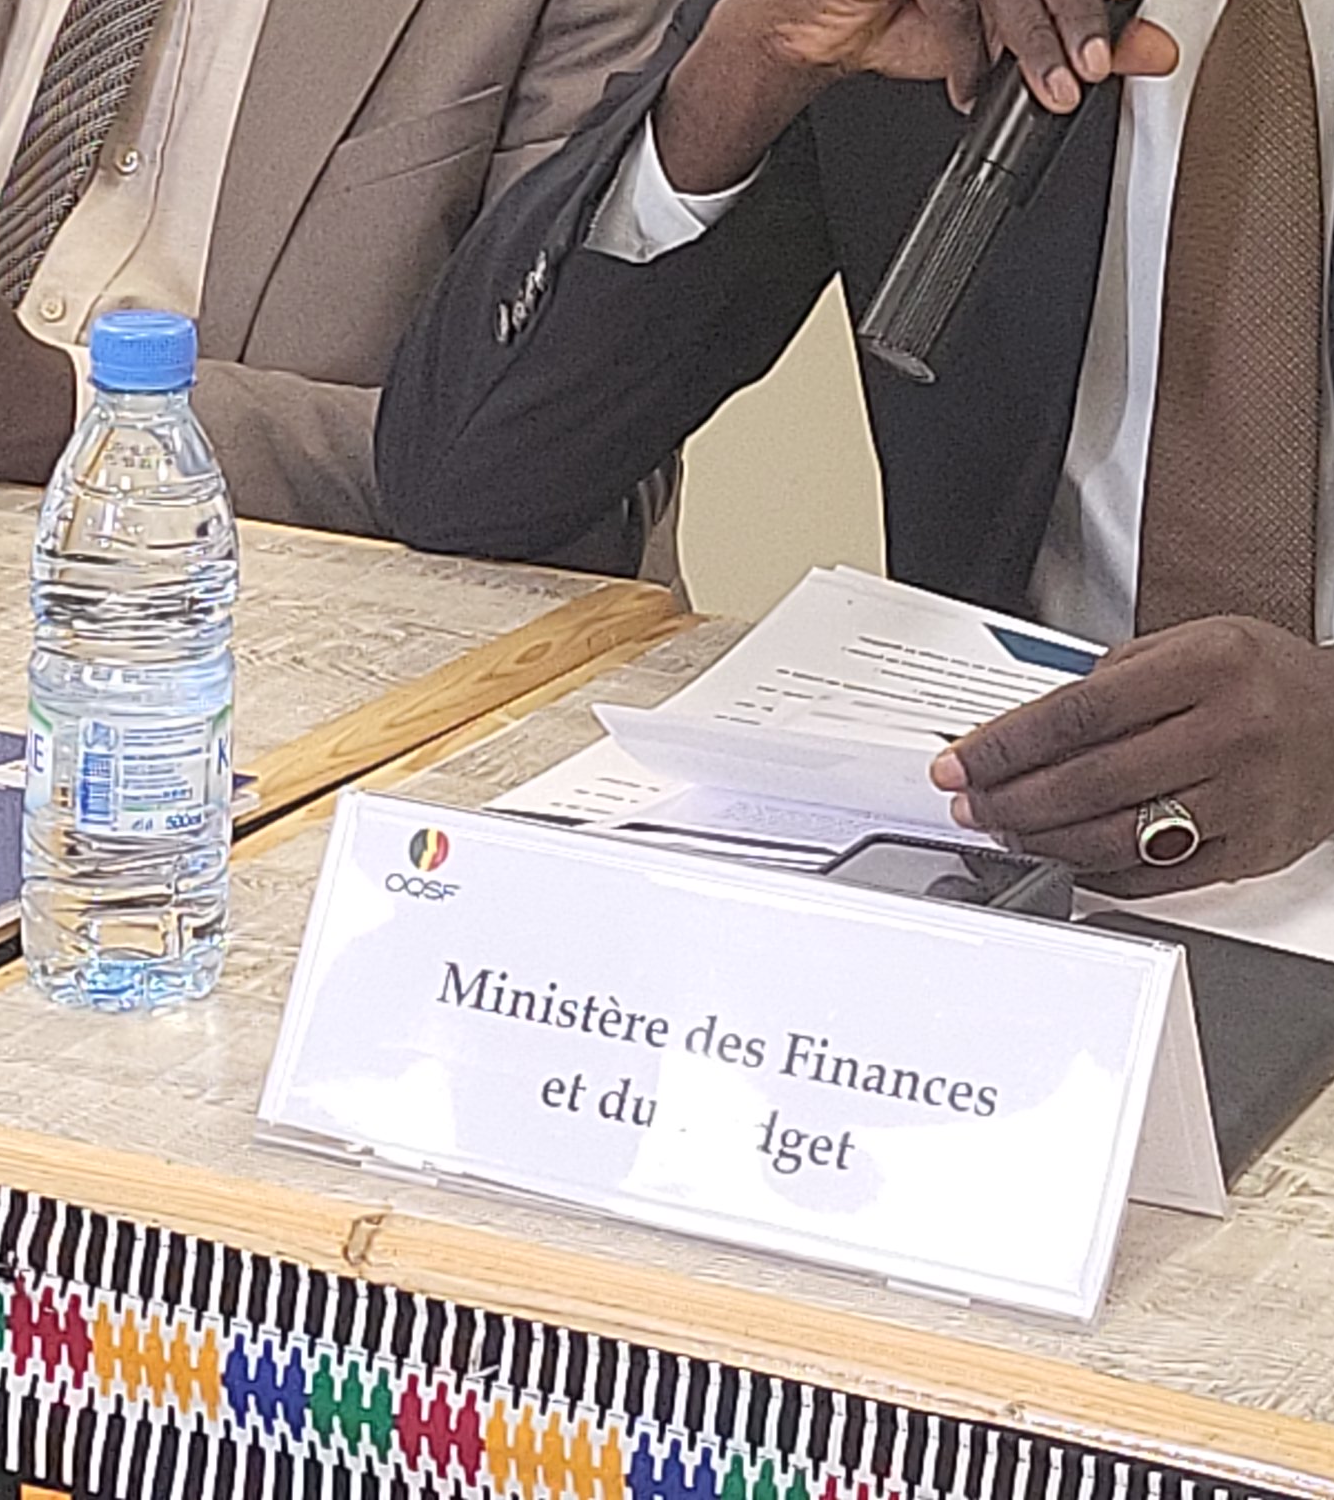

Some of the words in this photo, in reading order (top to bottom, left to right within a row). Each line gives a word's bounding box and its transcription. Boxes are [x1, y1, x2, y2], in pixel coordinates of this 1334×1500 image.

[384, 872, 462, 904] OQSF
[435, 960, 670, 1049] Ministère
[684, 1014, 766, 1069] des
[778, 1032, 999, 1118] Finances
[540, 1072, 587, 1114] et
[598, 1078, 658, 1128] du
